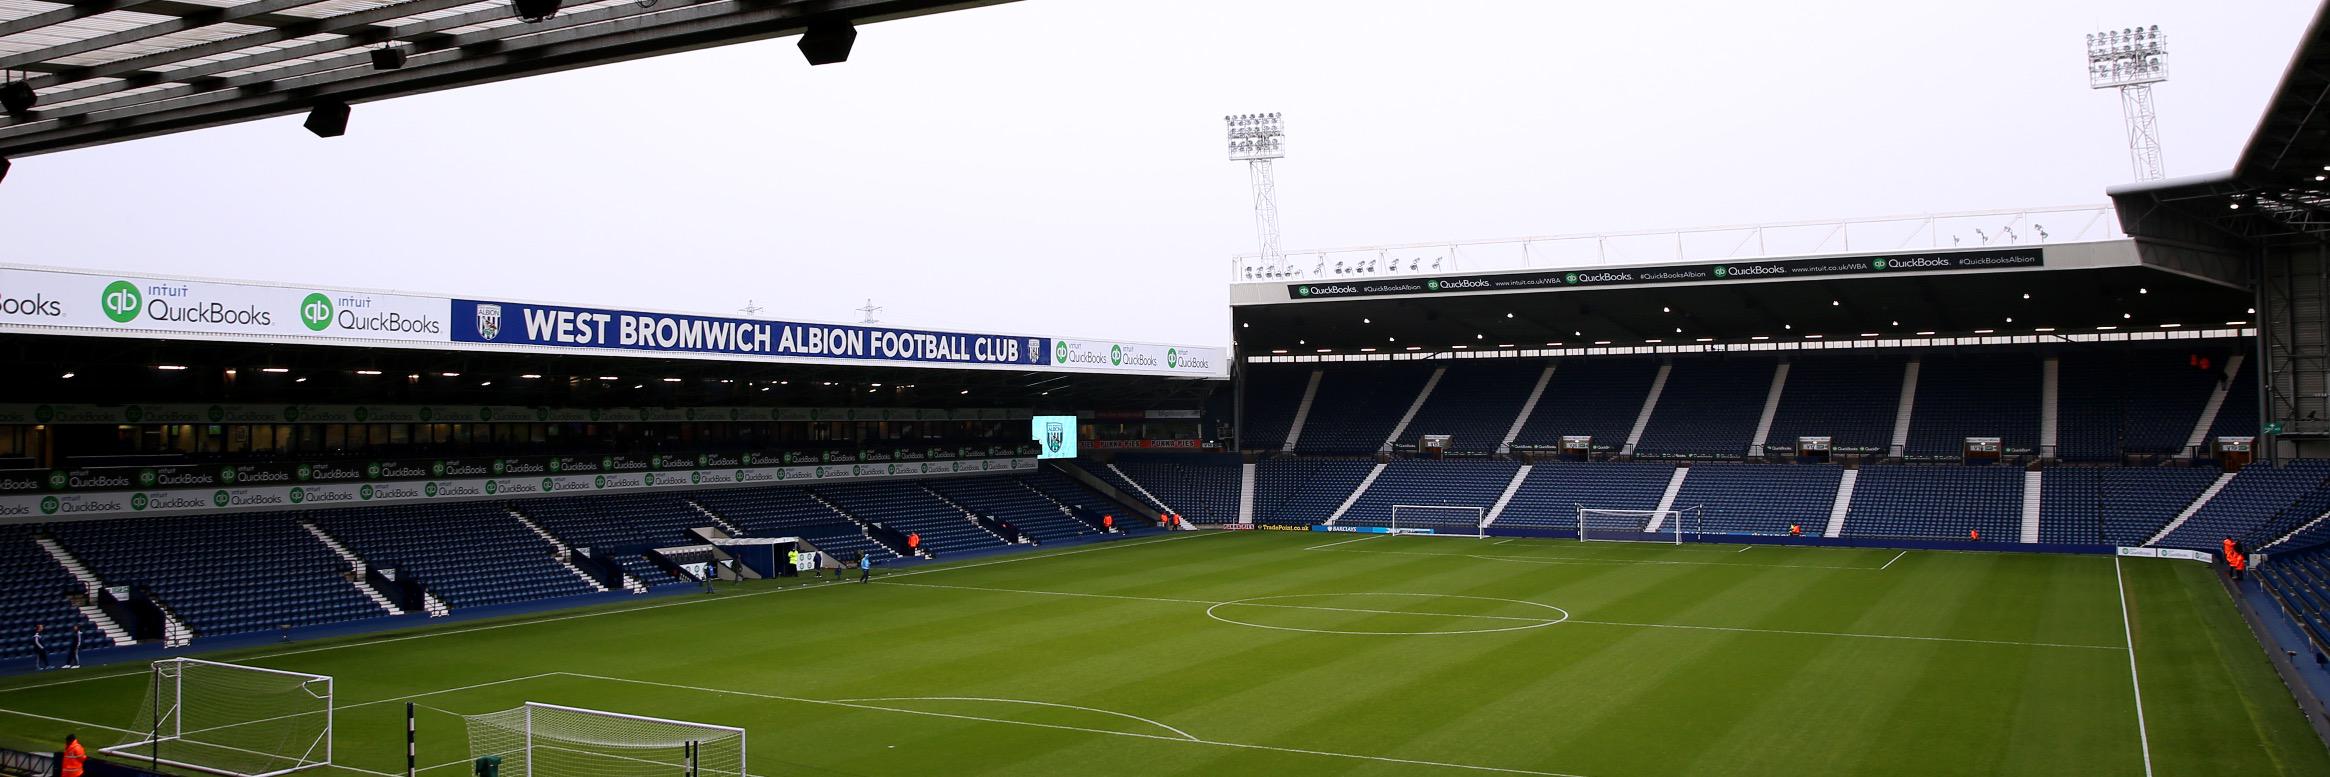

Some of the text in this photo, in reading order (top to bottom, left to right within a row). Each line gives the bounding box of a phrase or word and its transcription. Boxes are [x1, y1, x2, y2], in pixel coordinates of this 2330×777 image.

[1310, 285, 1357, 295] QuickBooks
[1440, 279, 1490, 289] QuickBooks
[1579, 272, 1632, 283] QuickBooks
[1728, 265, 1784, 276] QuickBooks
[1792, 263, 1867, 273] www.intuit.co.uk/WBA
[1888, 258, 1949, 268] QuickBooks
[1959, 256, 2035, 266] #QuickBooksAlbion
[148, 283, 188, 298] intuit
[0, 293, 61, 317] ooks
[338, 296, 371, 309] intuit
[148, 299, 271, 326] QuickBooks
[338, 309, 440, 334] QuickBooks
[523, 308, 1019, 362] WEST BROMWICH ALBION FOOTBALL CLUB
[1068, 350, 1107, 364] QuickBooks
[1122, 353, 1157, 366] QuickBooks
[1178, 356, 1209, 369] QuickBooks
[1151, 439, 1175, 447] PUKKA
[1177, 439, 1194, 447] PIES
[382, 466, 426, 478] QuickBooks
[446, 464, 488, 475] QuickBooks
[505, 463, 544, 473] QuickBooks
[157, 473, 214, 485] QuickBooks
[237, 471, 289, 482] QuickBooks
[312, 469, 360, 480] QuickBooks
[69, 476, 129, 488] QuickBooks
[305, 492, 353, 502] QuickBooks
[374, 488, 418, 499] QuickBooks
[439, 487, 481, 496] QuickBooks
[150, 498, 205, 509] QuickBooks
[231, 494, 282, 506] QuickBooks
[61, 501, 121, 513] QuickBooks
